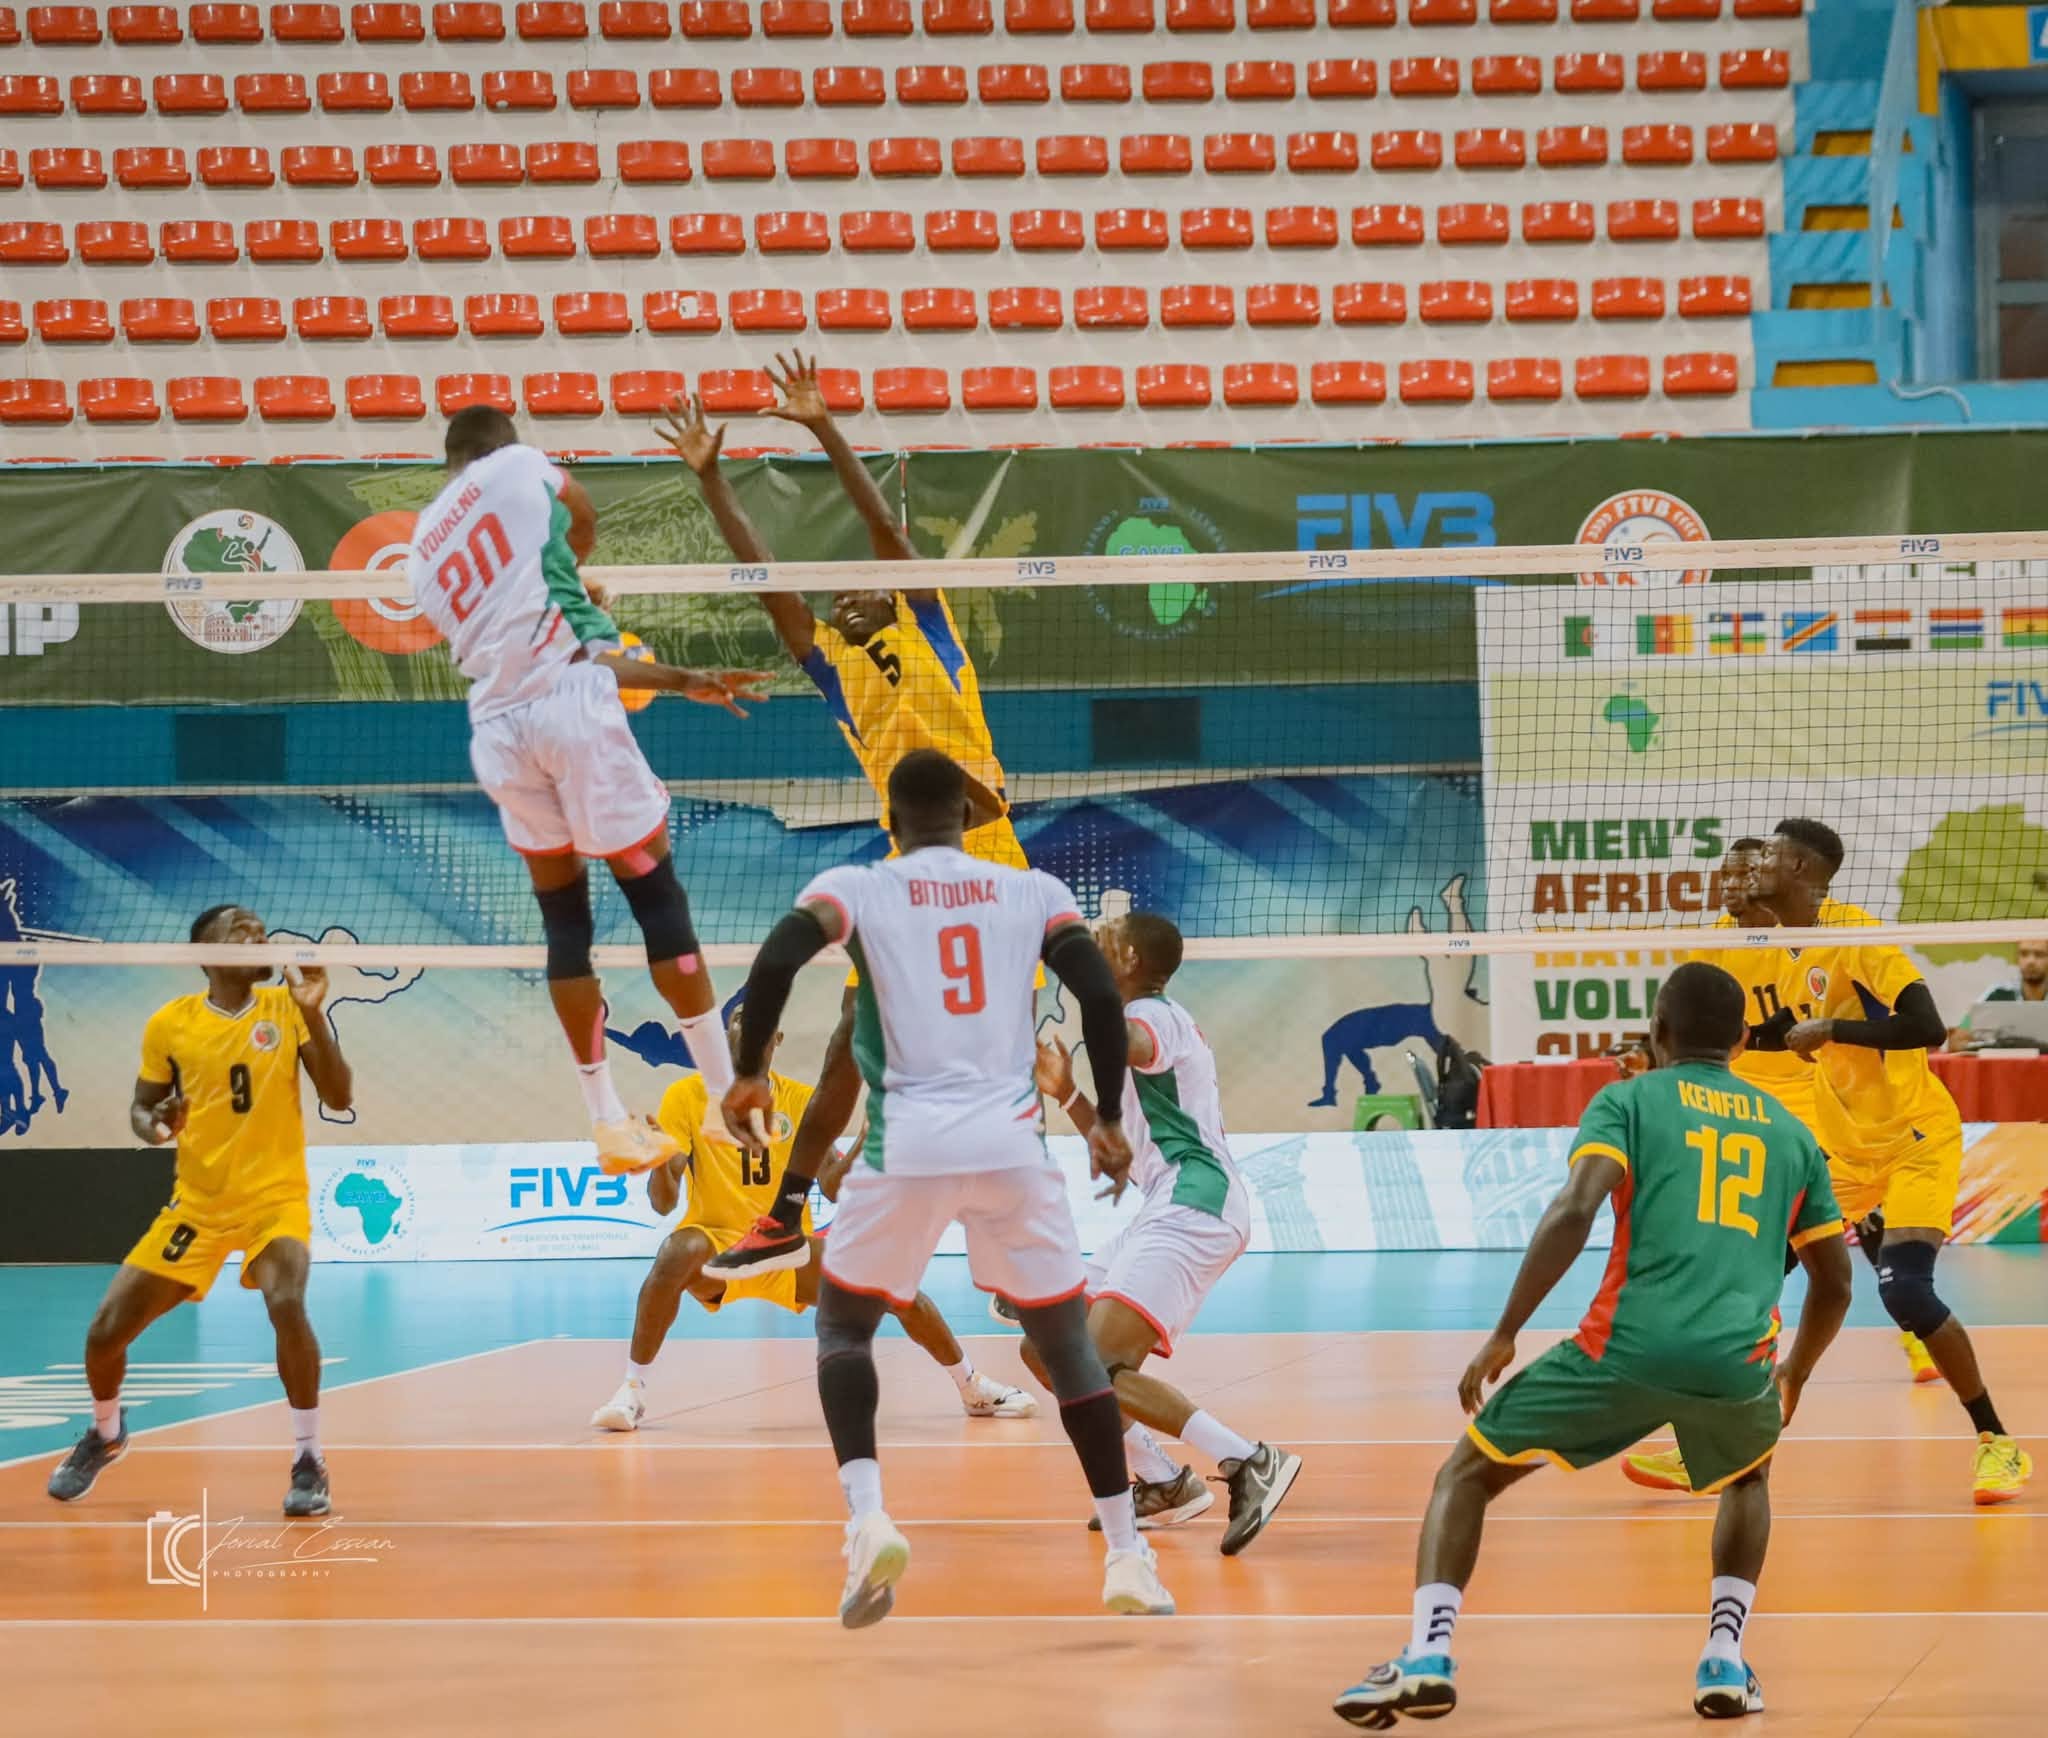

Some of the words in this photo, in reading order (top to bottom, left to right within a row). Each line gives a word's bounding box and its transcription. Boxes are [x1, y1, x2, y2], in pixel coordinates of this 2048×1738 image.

[417, 481, 482, 562] VOUKENG
[1296, 491, 1496, 551] FIVB
[1309, 555, 1347, 568] FIVB
[1604, 547, 1643, 560] FIVB
[1901, 539, 1940, 553] FIVB
[437, 512, 515, 624] 20
[730, 568, 768, 582] FIVB
[1017, 561, 1056, 576] FIVB
[865, 639, 901, 688] 5
[1531, 818, 1723, 860] MEN'S
[908, 879, 998, 909] BITOUNA
[938, 923, 987, 1016] 9
[230, 1063, 252, 1114] 9
[737, 1147, 771, 1186] 13
[1685, 1124, 1768, 1239] 12
[510, 1167, 628, 1208] FIVB
[162, 1223, 198, 1263] 9
